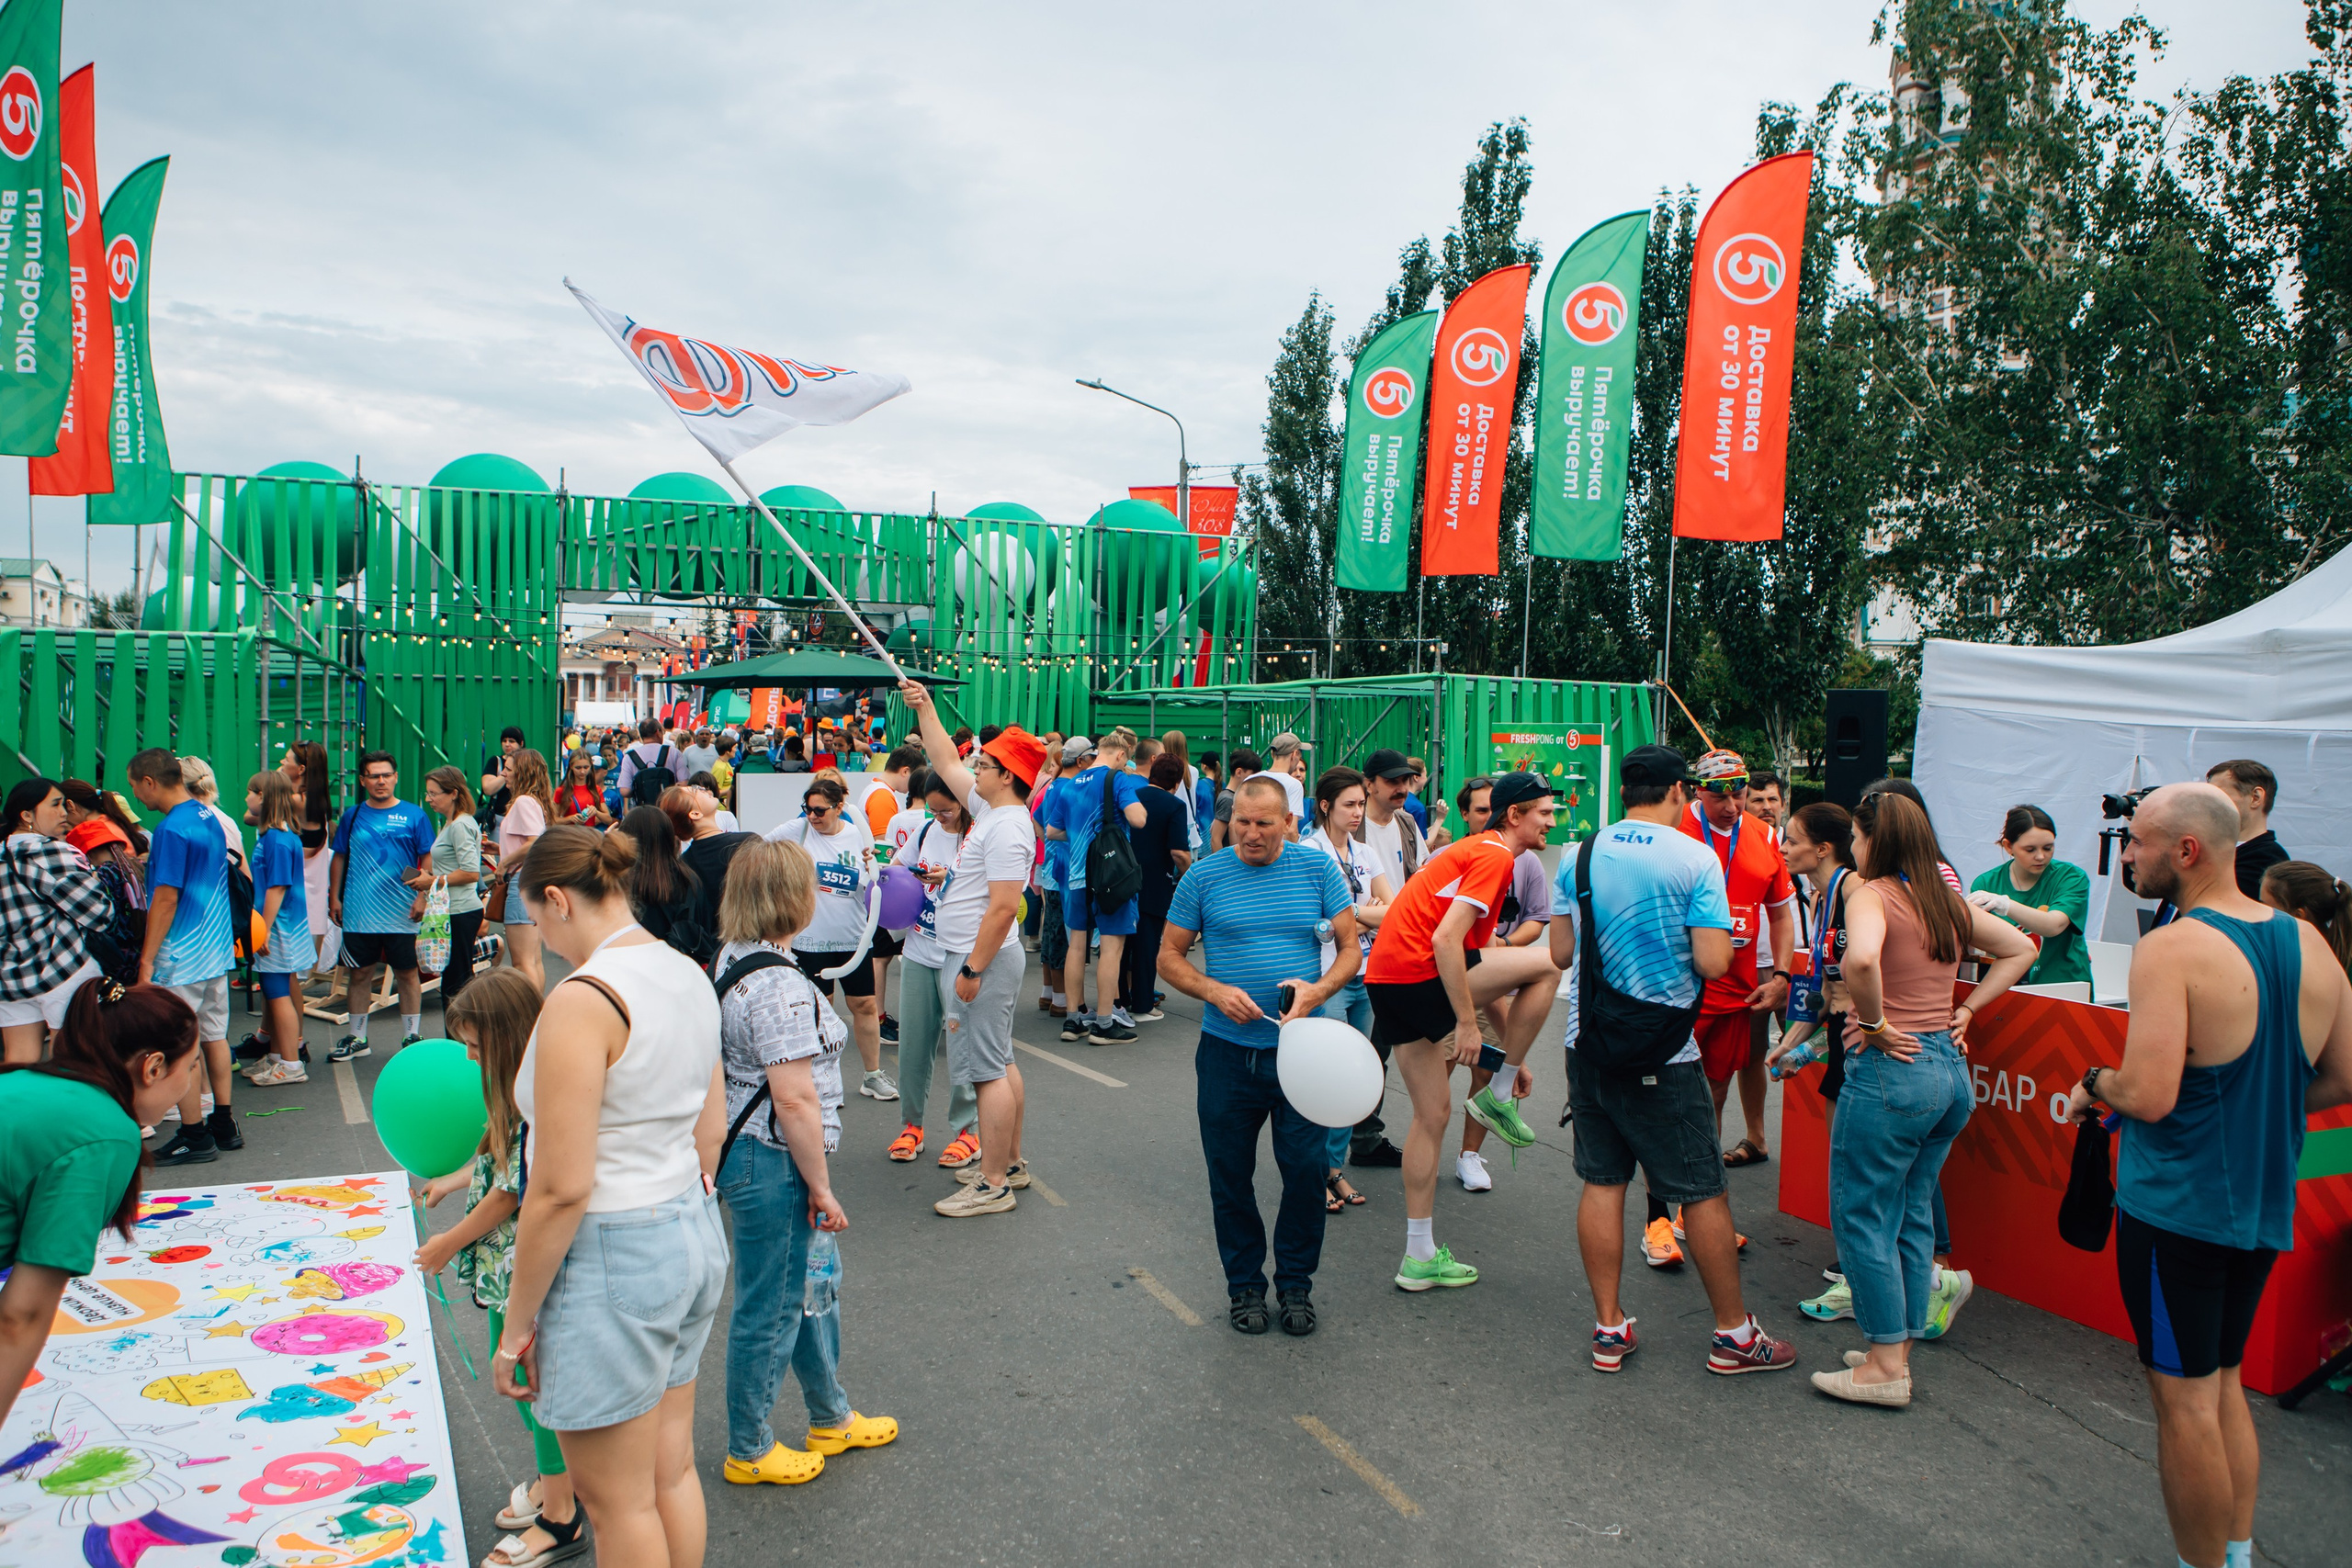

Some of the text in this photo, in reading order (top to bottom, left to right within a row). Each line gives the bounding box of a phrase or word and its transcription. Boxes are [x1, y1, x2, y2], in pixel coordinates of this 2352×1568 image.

[15, 188, 44, 373] Пятёрочка
[1721, 361, 1741, 390] 30
[1743, 325, 1771, 452] Доставка
[1454, 433, 1471, 457] 30
[1468, 403, 1494, 505] Доставка
[1562, 367, 1585, 500] выручает!
[1588, 367, 1612, 501] Пятёрочка
[1195, 518, 1226, 533] 308
[1361, 434, 1380, 543] выручает!
[1379, 435, 1402, 544] Пятёрочка
[1510, 733, 1555, 745] FRESHPONG
[822, 870, 852, 886] 3512
[1754, 1343, 1774, 1364] N
